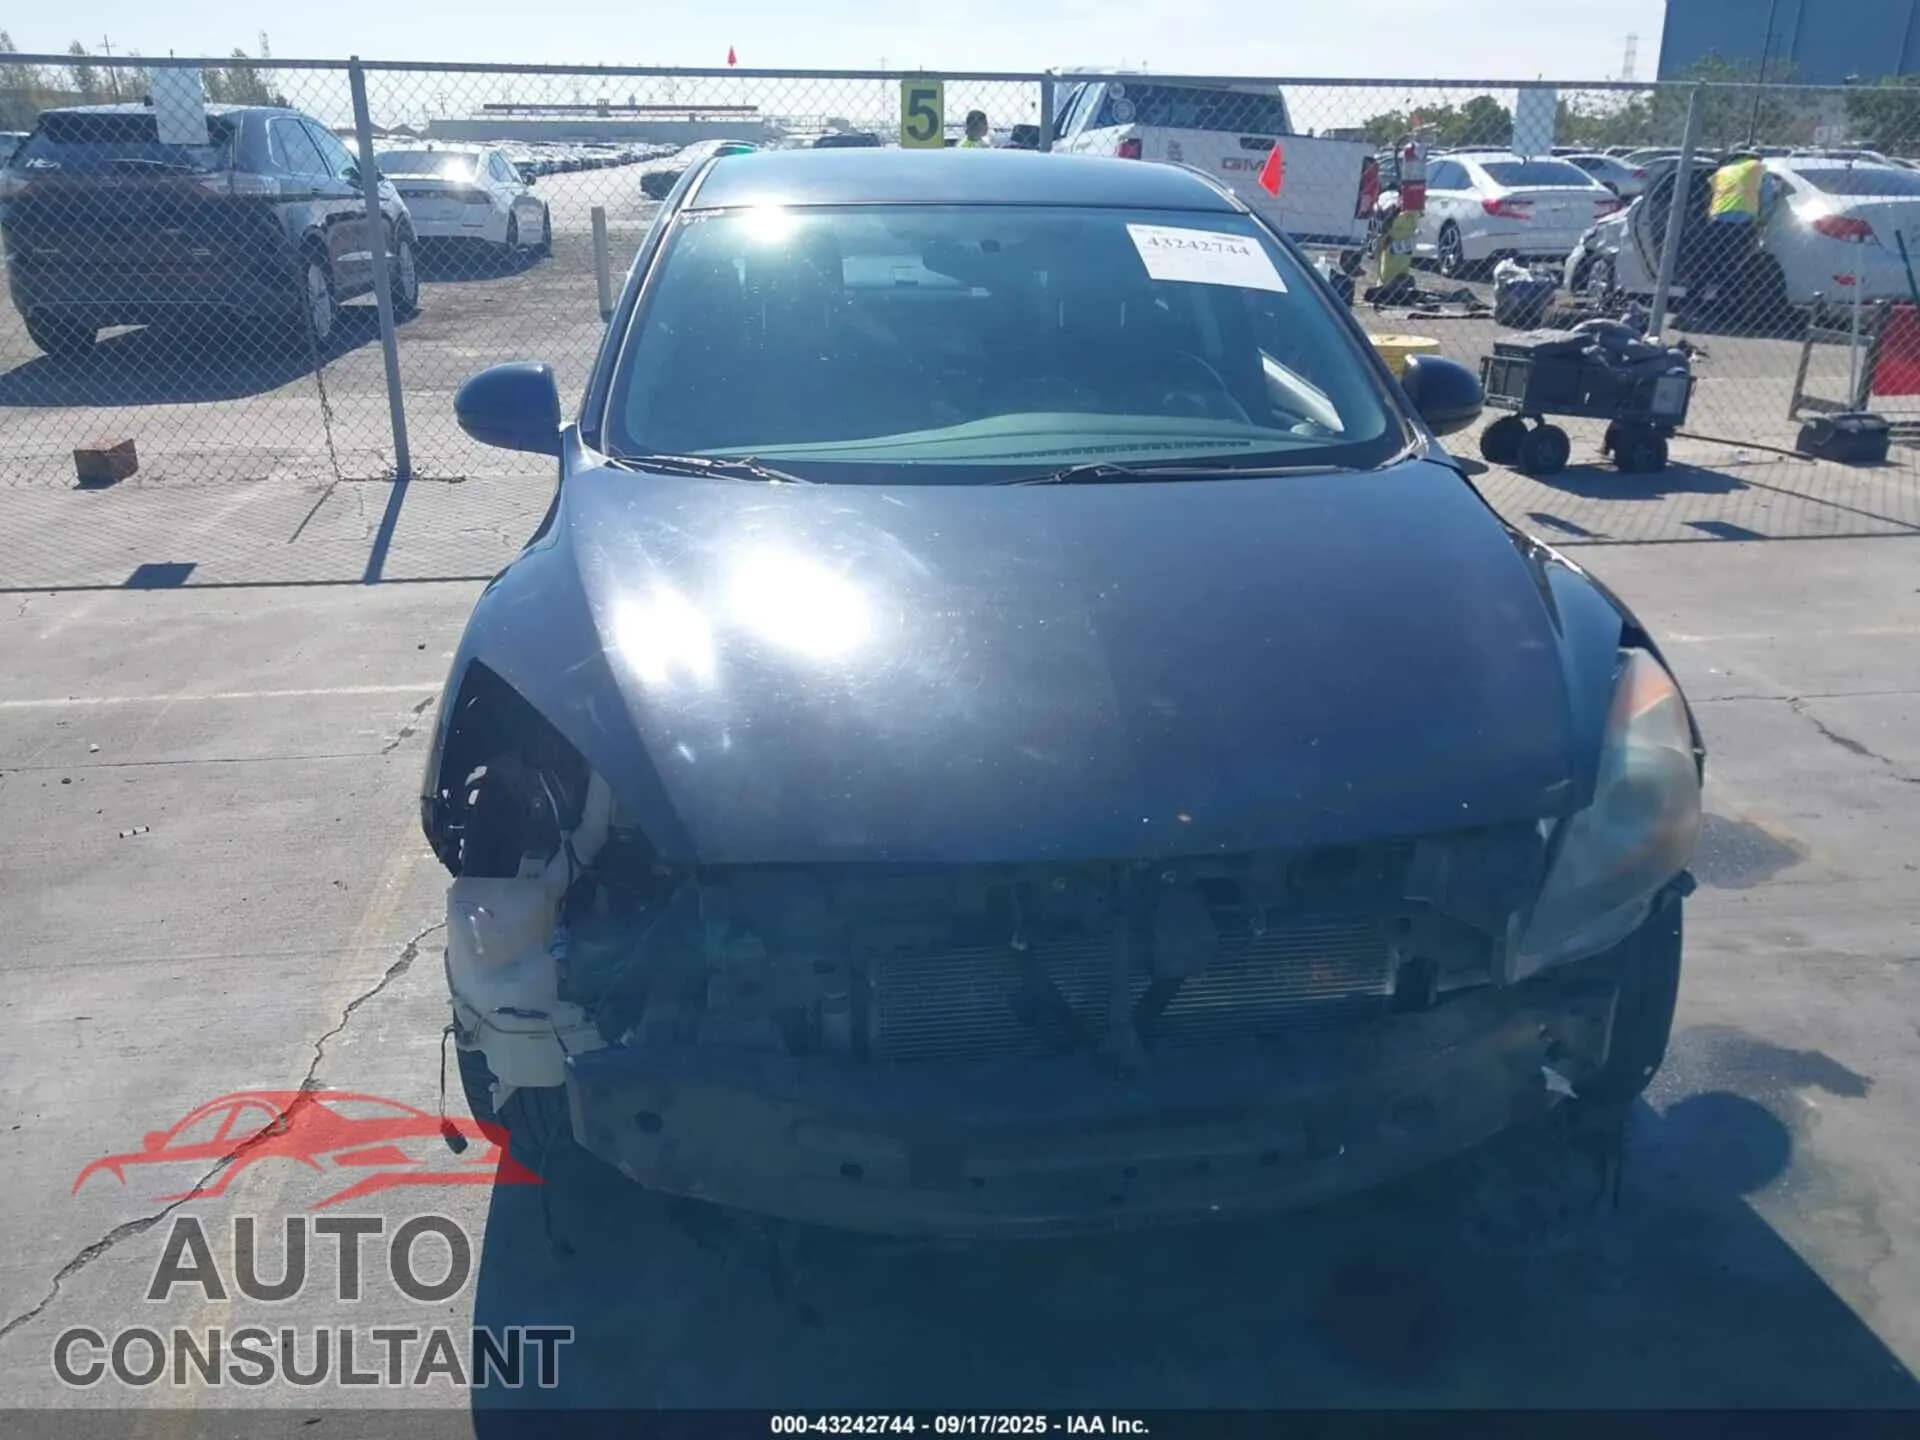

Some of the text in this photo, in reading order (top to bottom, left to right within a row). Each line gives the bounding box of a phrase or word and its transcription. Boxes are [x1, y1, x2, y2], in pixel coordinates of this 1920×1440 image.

[907, 89, 939, 141] 5
[1222, 157, 1287, 173] GM
[1147, 236, 1250, 256] 43242744
